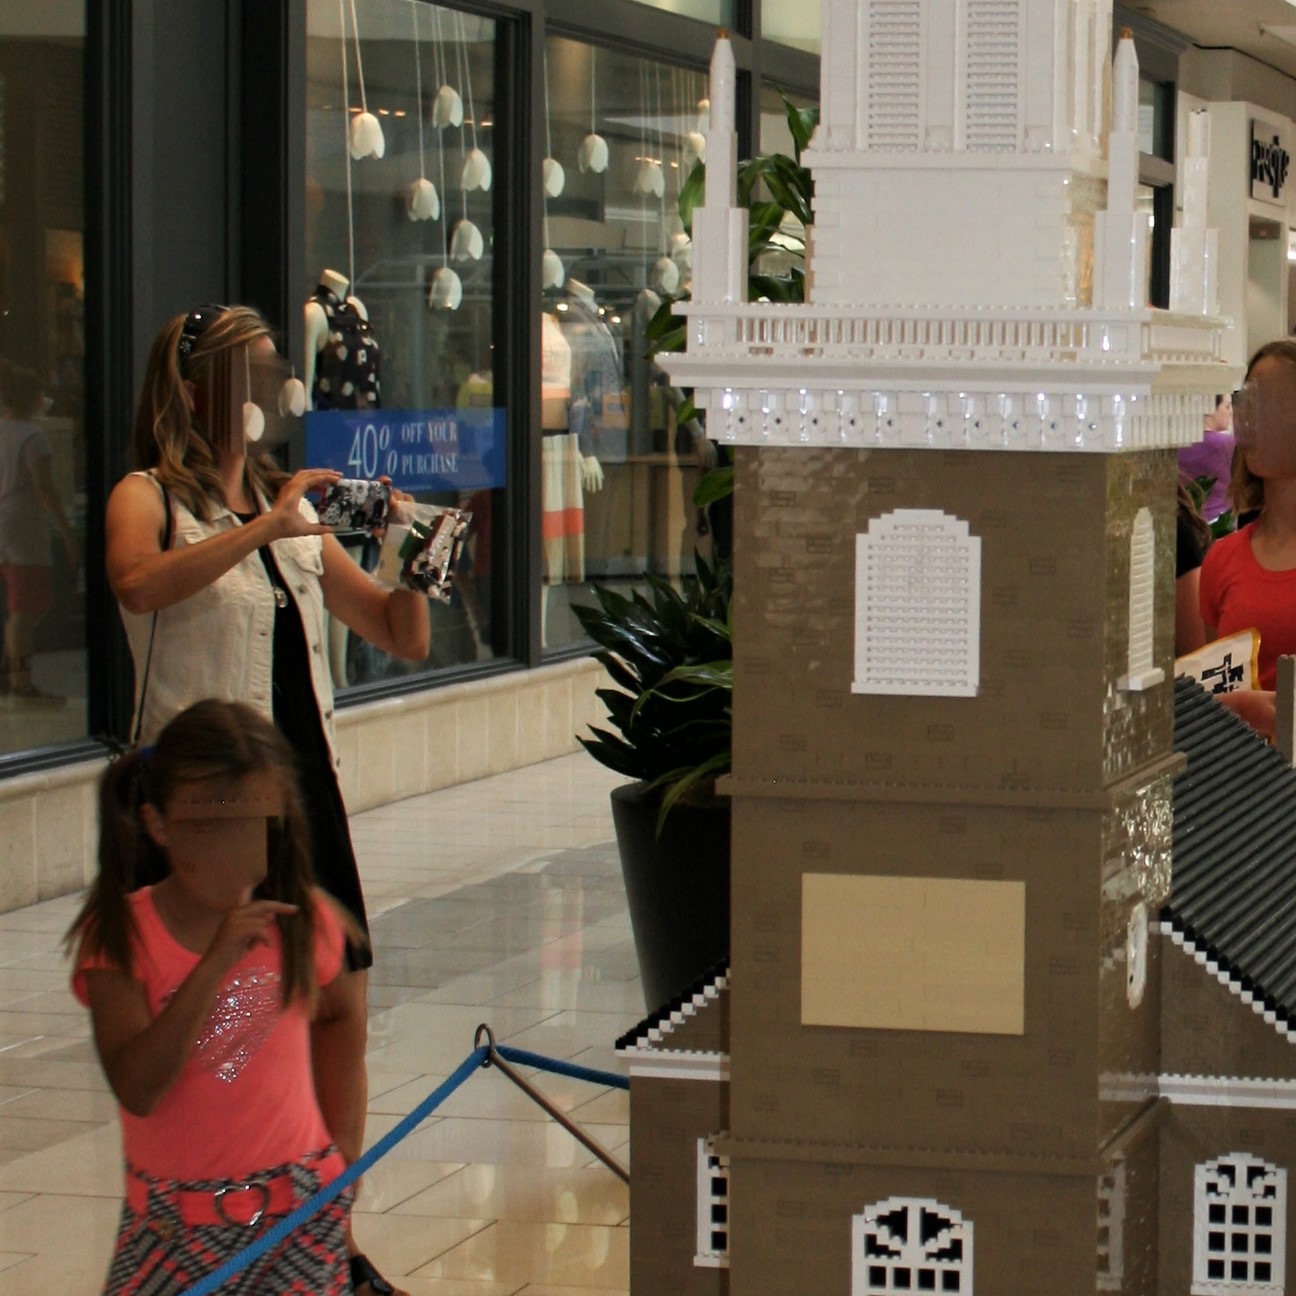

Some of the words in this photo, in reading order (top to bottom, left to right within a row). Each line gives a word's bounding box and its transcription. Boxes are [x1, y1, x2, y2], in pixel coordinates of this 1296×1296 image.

[402, 423, 424, 443] OFF
[427, 422, 457, 442] YOUR
[348, 423, 398, 479] 40%
[402, 454, 458, 475] PURCHASE
